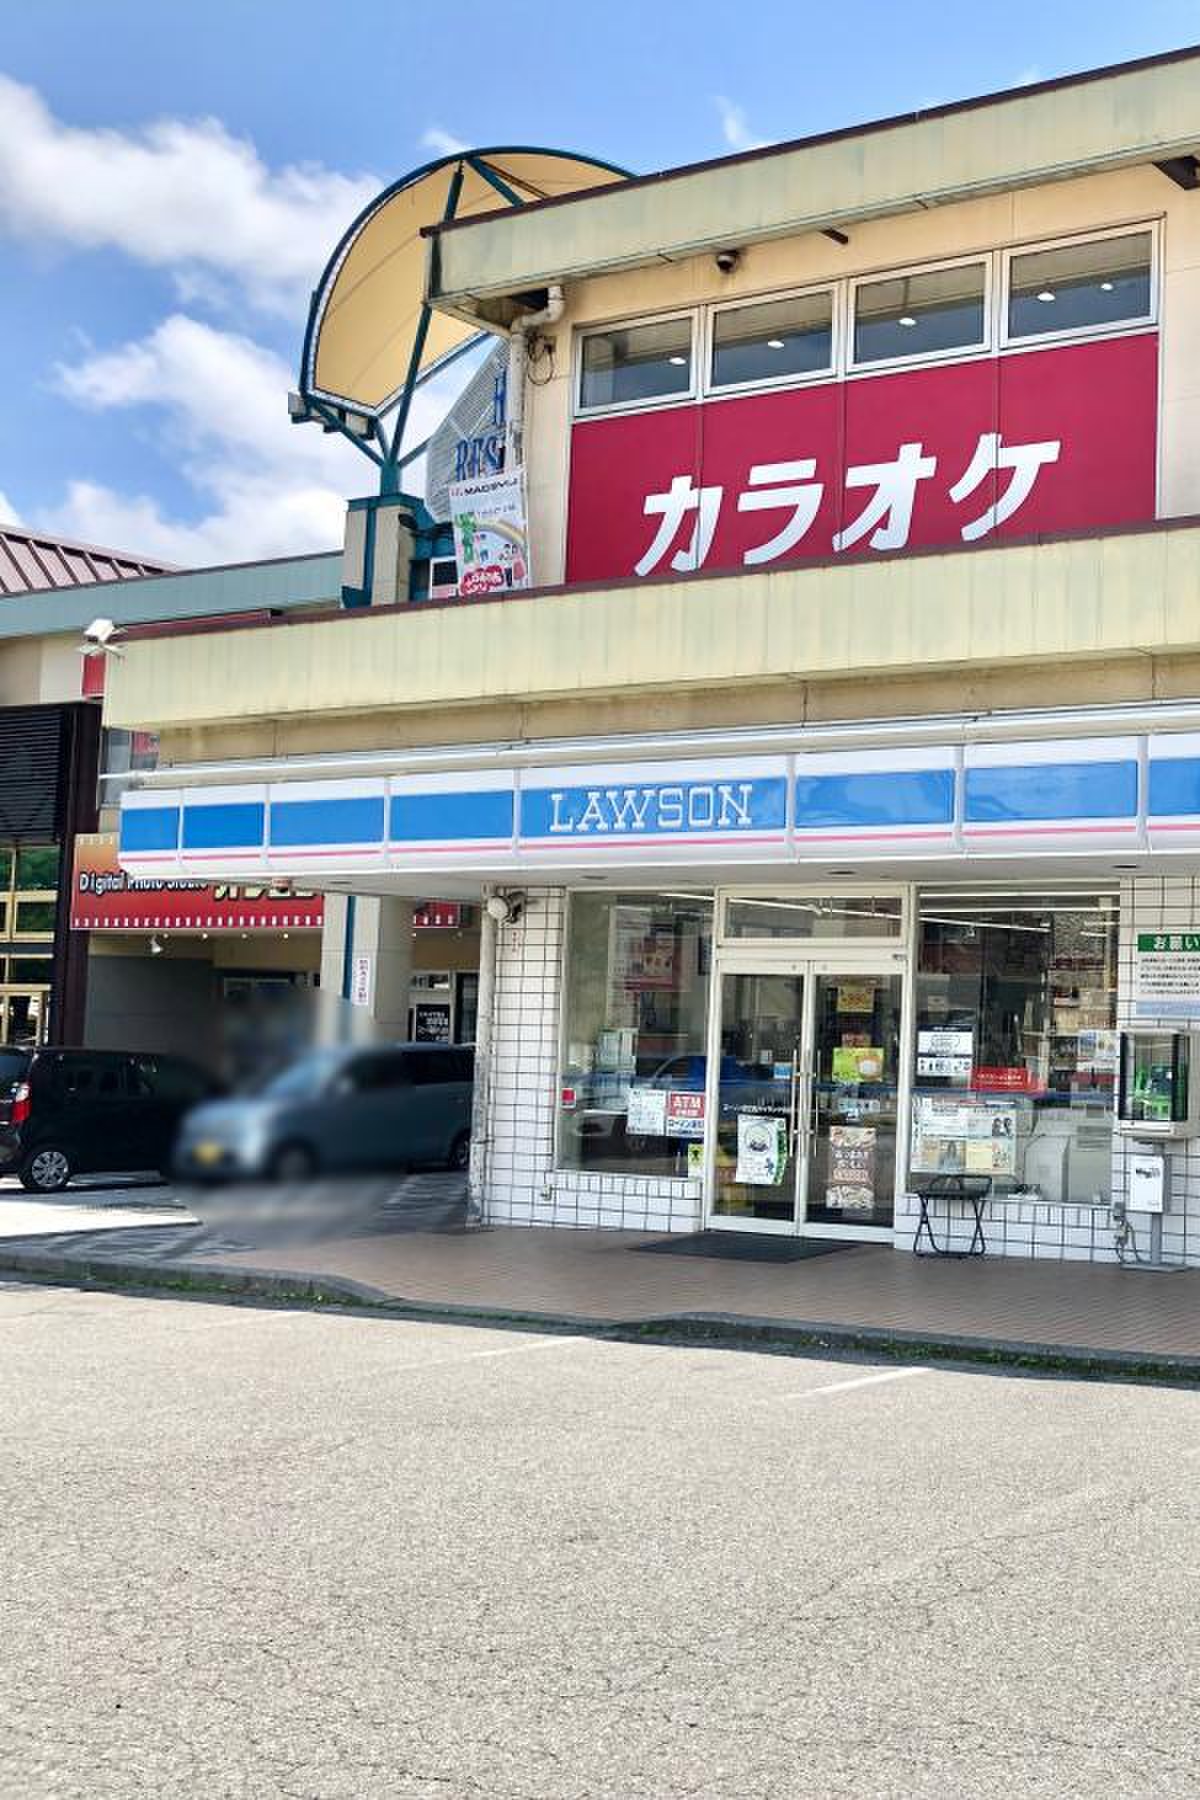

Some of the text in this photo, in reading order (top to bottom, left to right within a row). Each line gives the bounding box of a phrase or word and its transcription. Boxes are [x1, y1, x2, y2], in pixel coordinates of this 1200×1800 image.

[634, 432, 1061, 577] カラオケ
[550, 784, 753, 832] LAWSON
[79, 871, 127, 896] Digital
[1153, 936, 1200, 951] お願い
